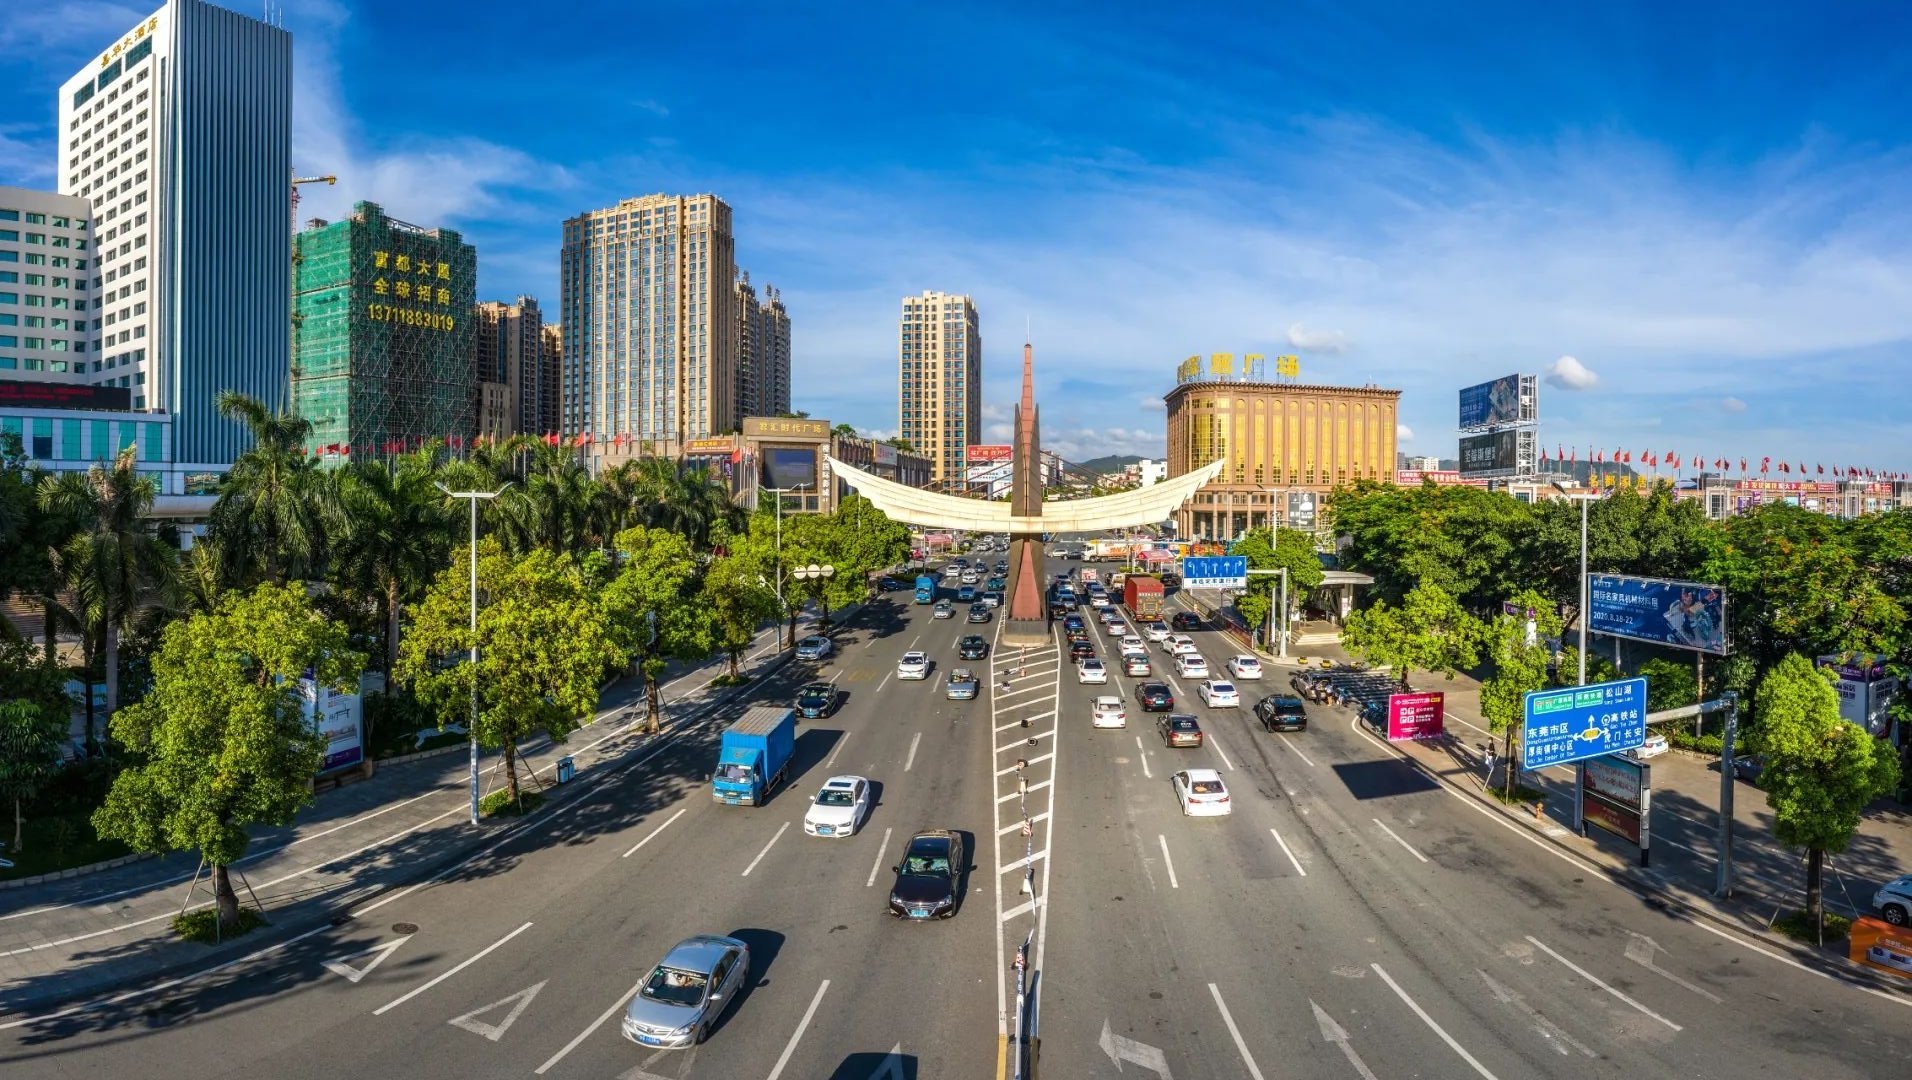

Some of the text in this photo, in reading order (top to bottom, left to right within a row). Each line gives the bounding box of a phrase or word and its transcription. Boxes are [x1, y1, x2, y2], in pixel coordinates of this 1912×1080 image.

[374, 277, 450, 305] 全球招商
[369, 304, 454, 331] 13711883019
[1606, 685, 1632, 697] 松山湖
[1610, 710, 1638, 723] 高铁站
[1527, 722, 1569, 739] 东莞市区
[1528, 739, 1574, 758] 厚街镇中心区
